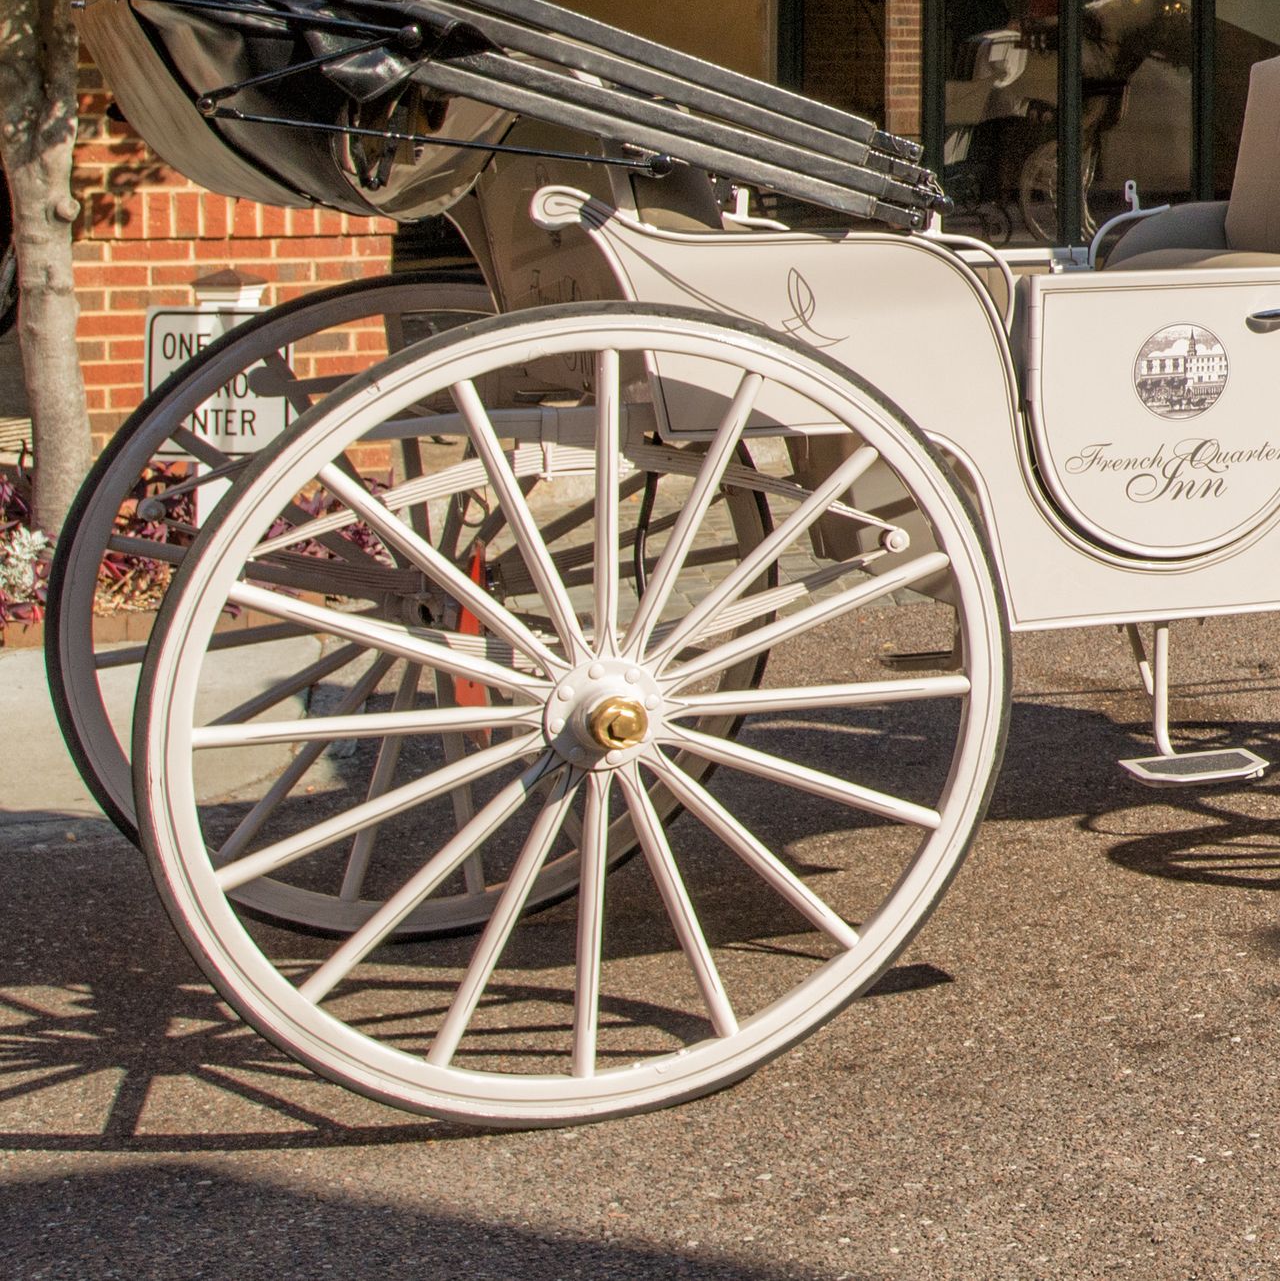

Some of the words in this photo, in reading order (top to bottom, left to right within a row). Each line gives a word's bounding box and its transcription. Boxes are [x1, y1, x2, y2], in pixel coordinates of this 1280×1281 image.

[191, 409, 256, 436] NTER
[1064, 442, 1166, 475] French
[1125, 452, 1228, 504] Inn
